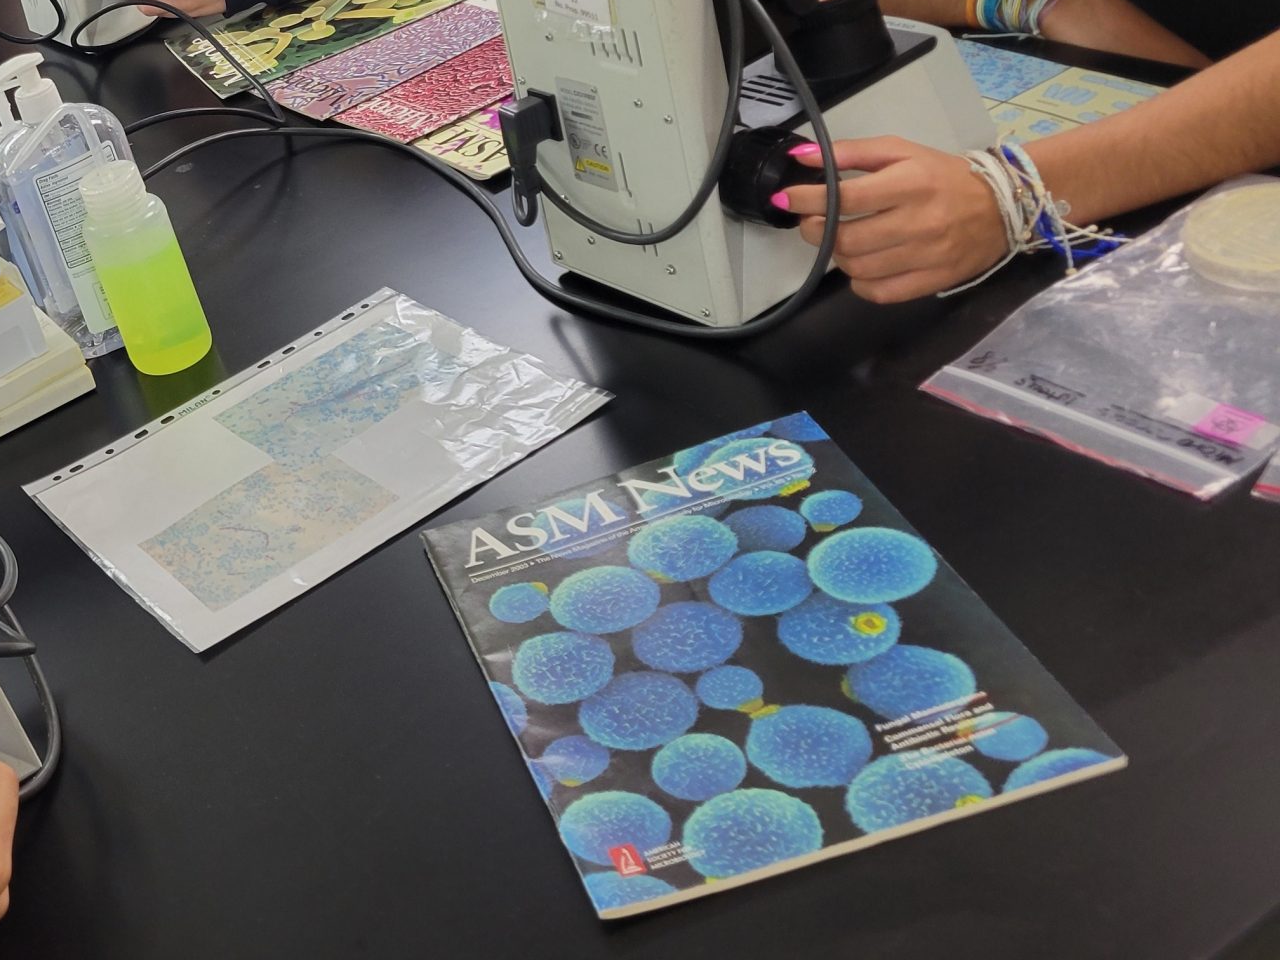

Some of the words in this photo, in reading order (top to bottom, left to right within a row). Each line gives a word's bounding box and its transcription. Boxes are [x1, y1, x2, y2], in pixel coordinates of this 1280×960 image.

[464, 489, 626, 569] ASM
[617, 439, 802, 515] News
[471, 569, 510, 584] December
[535, 555, 552, 565] The
[972, 702, 995, 714] and
[891, 729, 941, 751] Antibiotic
